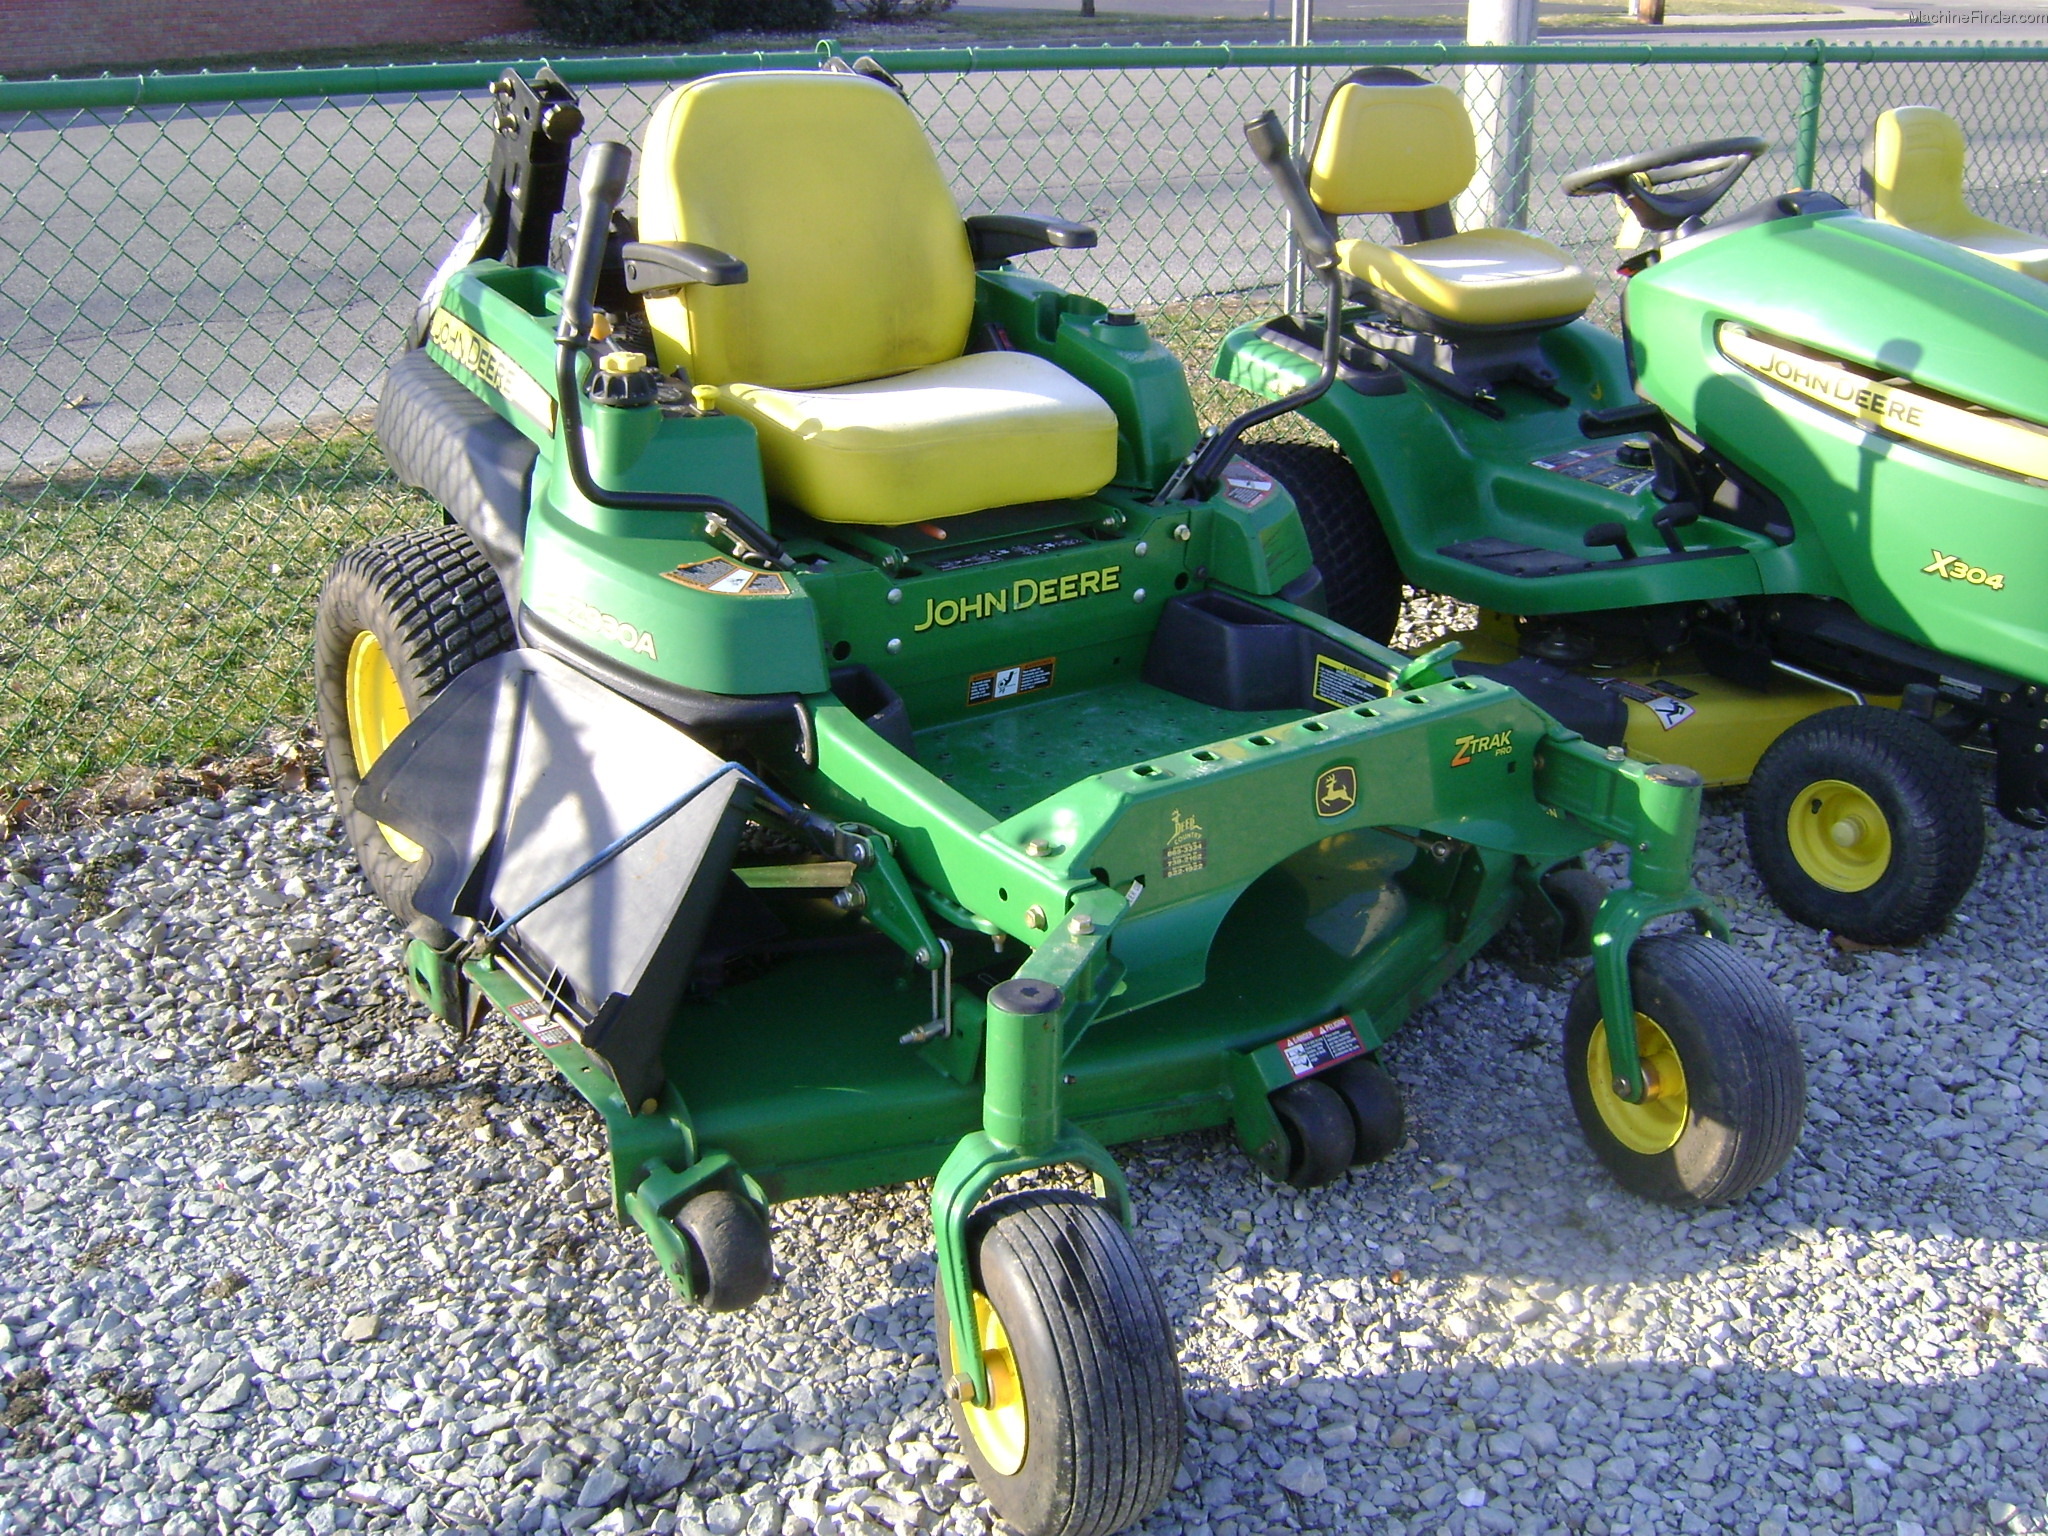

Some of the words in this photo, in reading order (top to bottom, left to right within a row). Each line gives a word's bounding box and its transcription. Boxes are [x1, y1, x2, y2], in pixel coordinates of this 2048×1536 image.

[433, 316, 464, 362] JOHN
[467, 335, 516, 395] DEERE
[1759, 352, 1830, 395] JOHN
[1833, 377, 1923, 428] DEERE
[1920, 548, 2005, 591] X304
[914, 588, 1007, 632] JOHN
[1012, 565, 1121, 611] DEERE
[1451, 729, 1513, 768] ZTRAK
[1495, 745, 1513, 757] PRO
[1173, 831, 1203, 846] COUNTRY
